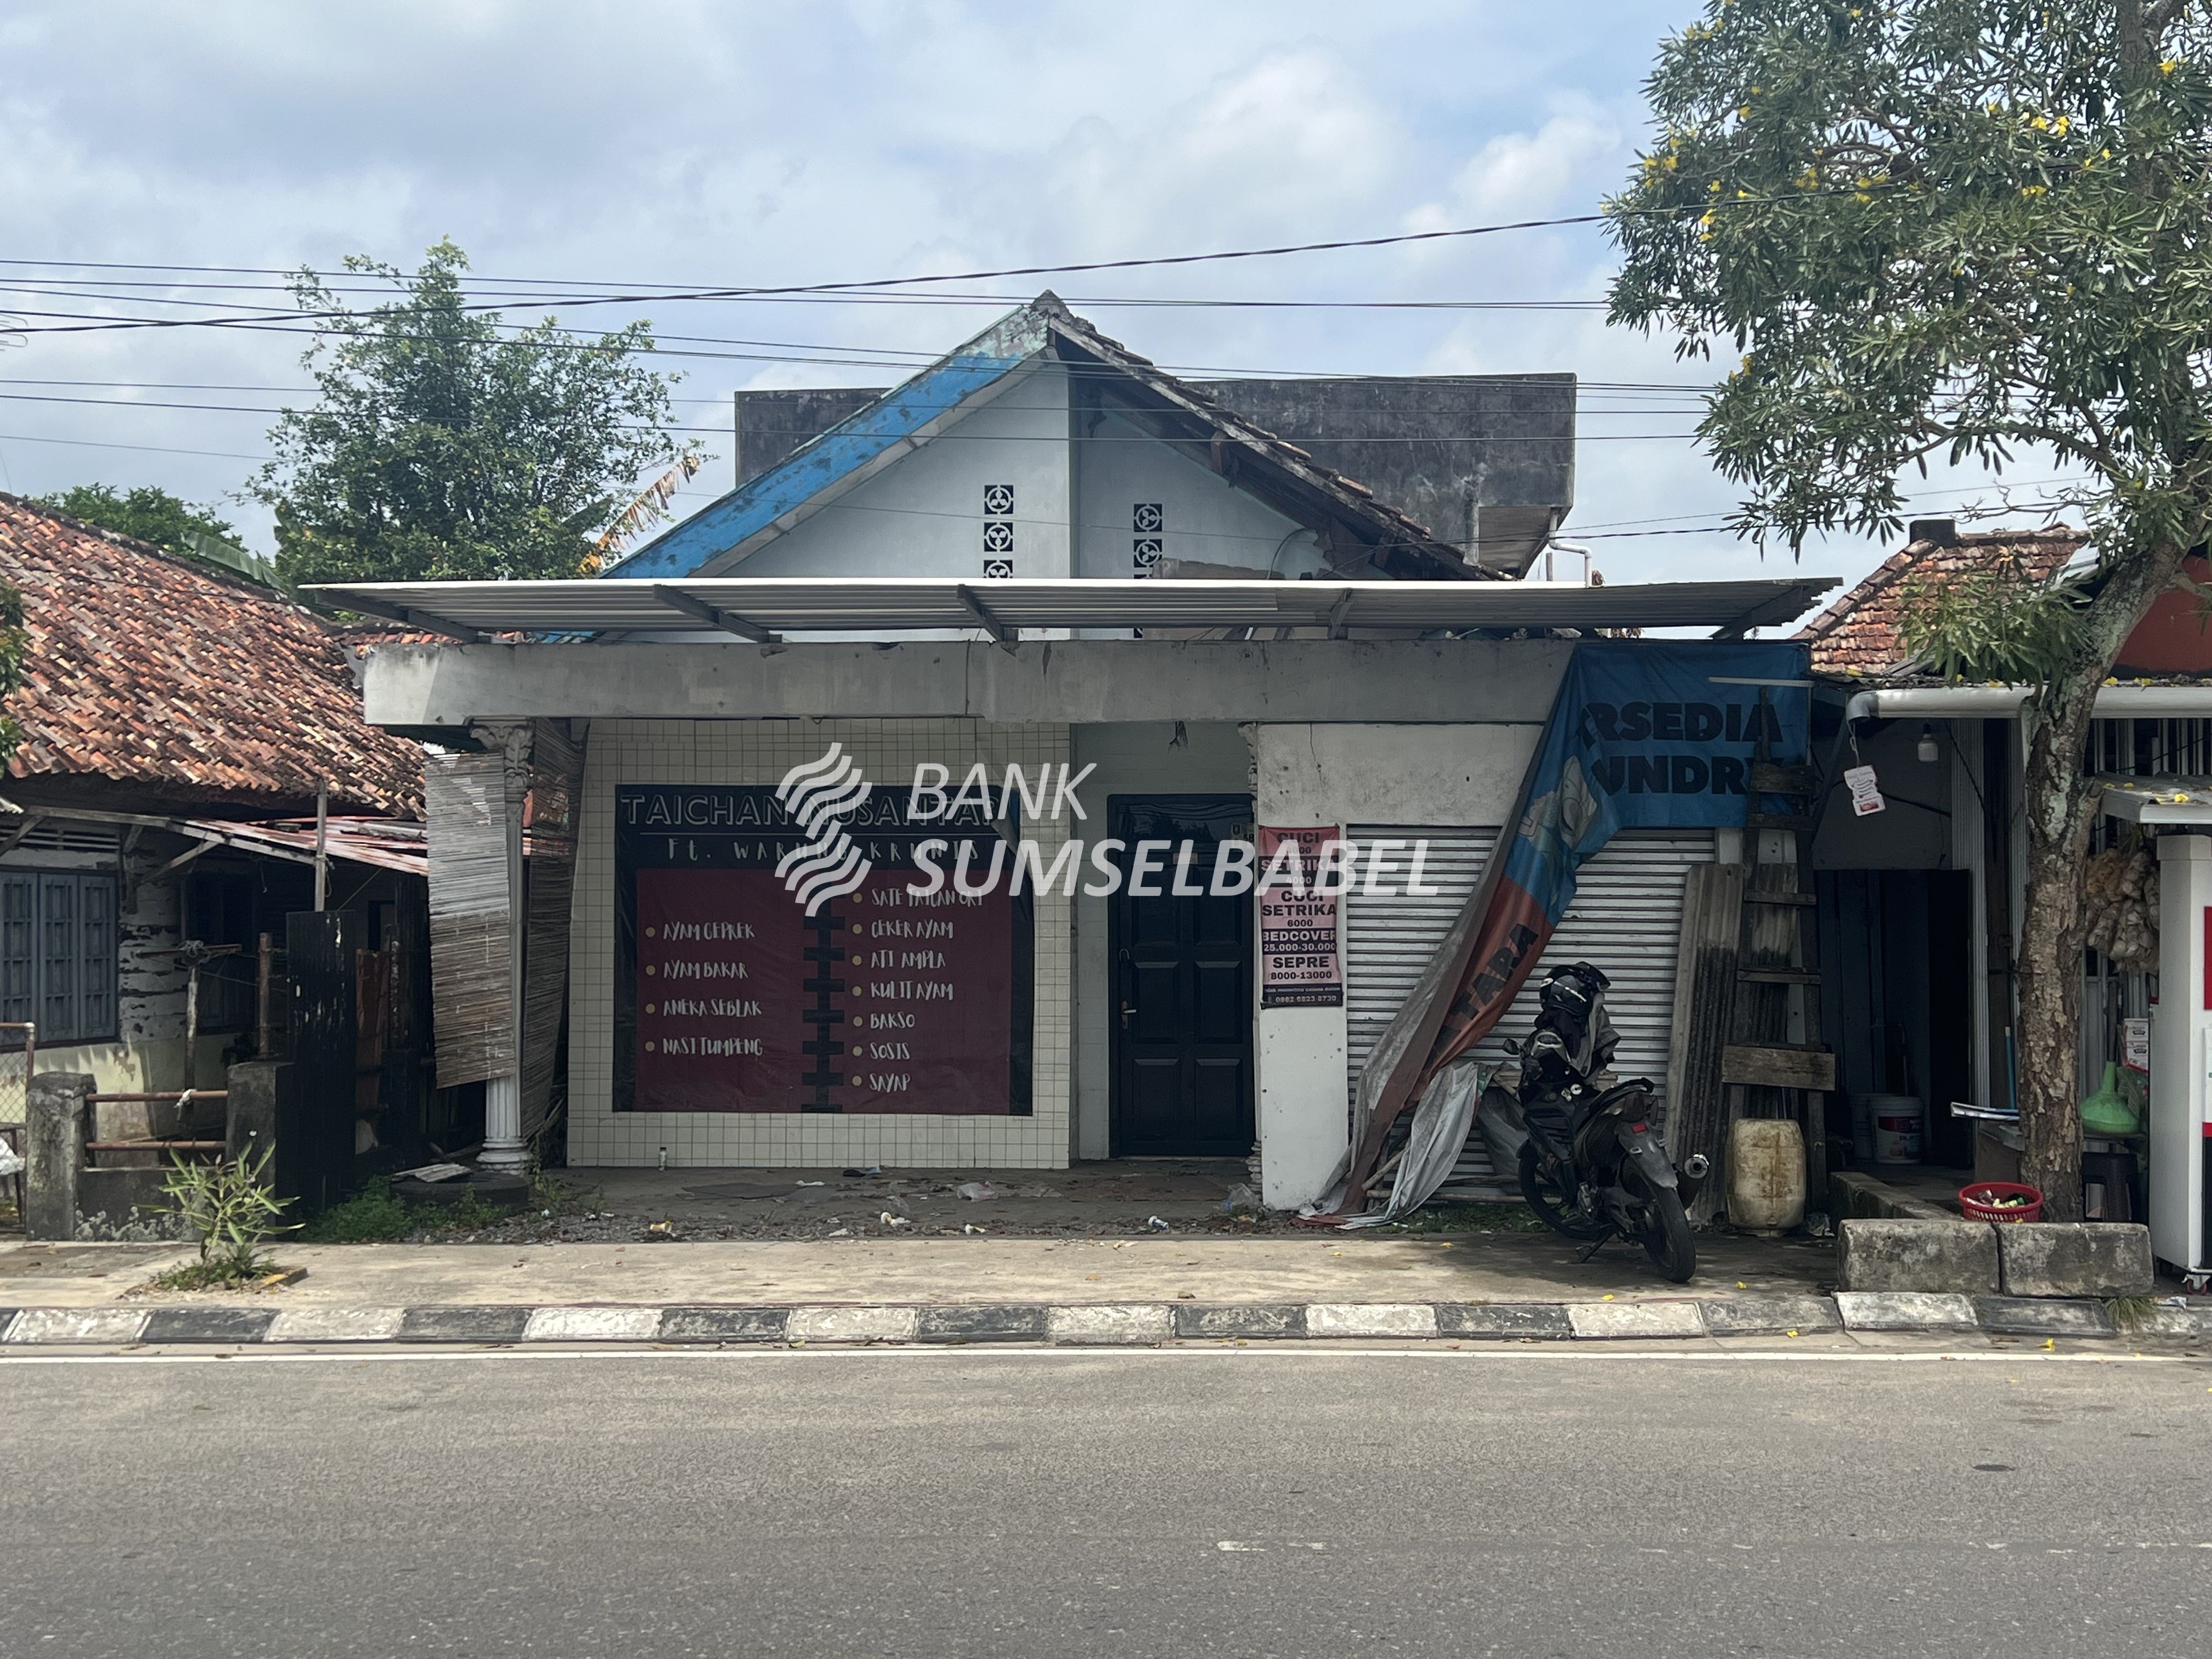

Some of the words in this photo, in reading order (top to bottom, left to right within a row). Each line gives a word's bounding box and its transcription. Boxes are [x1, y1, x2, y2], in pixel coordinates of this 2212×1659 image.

[1577, 702, 1784, 749] RSEDIA
[1591, 755, 1784, 795] UNDR
[620, 794, 788, 826] TAICHAN
[804, 794, 1000, 827] NUSANTAR
[1277, 832, 1320, 844] CUCI
[733, 840, 848, 861] WARUNG
[870, 839, 979, 862] KRUNIS
[1261, 859, 1337, 871] SETRIKA
[872, 888, 903, 907] SATE
[959, 888, 983, 907] ORI
[1280, 889, 1324, 902] CUCI
[1262, 904, 1336, 917] SETRIKA
[663, 921, 700, 941] AYAM
[871, 919, 913, 938] CEKER
[916, 918, 953, 939] AYAM
[1287, 918, 1313, 927] 6000
[663, 959, 700, 979] AYAM
[704, 961, 748, 979] BAKAR
[871, 950, 894, 968] ATI
[901, 950, 946, 969] AMPLA
[1272, 956, 1330, 968] SEPRE
[1271, 970, 1332, 980] 8000-13000
[871, 980, 913, 1000] KULIT
[916, 980, 953, 1000] AYAM
[663, 998, 708, 1017] ANEKA
[711, 998, 763, 1017] SEBLAK
[870, 1012, 916, 1030] BAKSO
[663, 1037, 696, 1056] NASI
[699, 1037, 763, 1057] TUMPENG
[870, 1042, 911, 1060] SOSIS
[870, 1073, 911, 1093] SAYAP
